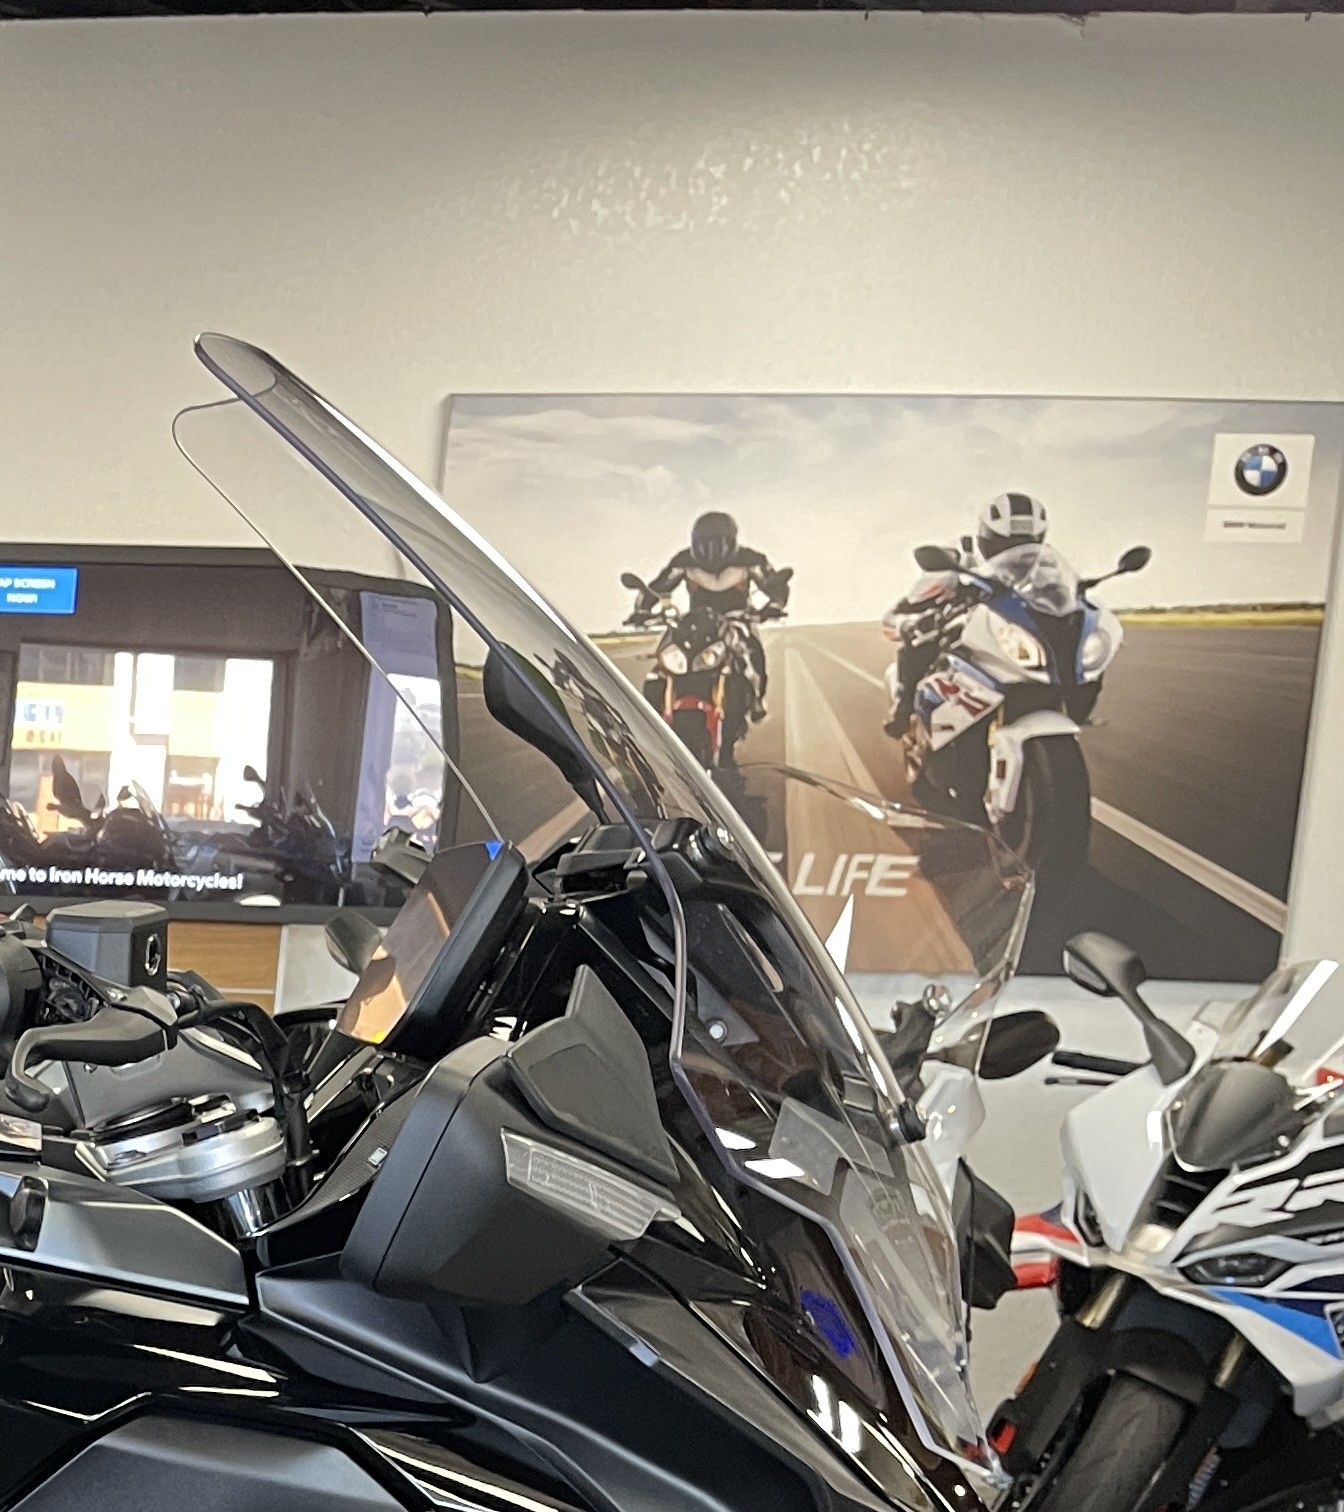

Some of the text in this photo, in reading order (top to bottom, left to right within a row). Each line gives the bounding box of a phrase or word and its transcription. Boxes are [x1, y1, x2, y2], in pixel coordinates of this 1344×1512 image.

[28, 866, 47, 883] to
[49, 866, 83, 884] Iron
[85, 867, 134, 886] Horse
[136, 869, 244, 892] Motorcycles!
[792, 853, 920, 896] LIFE
